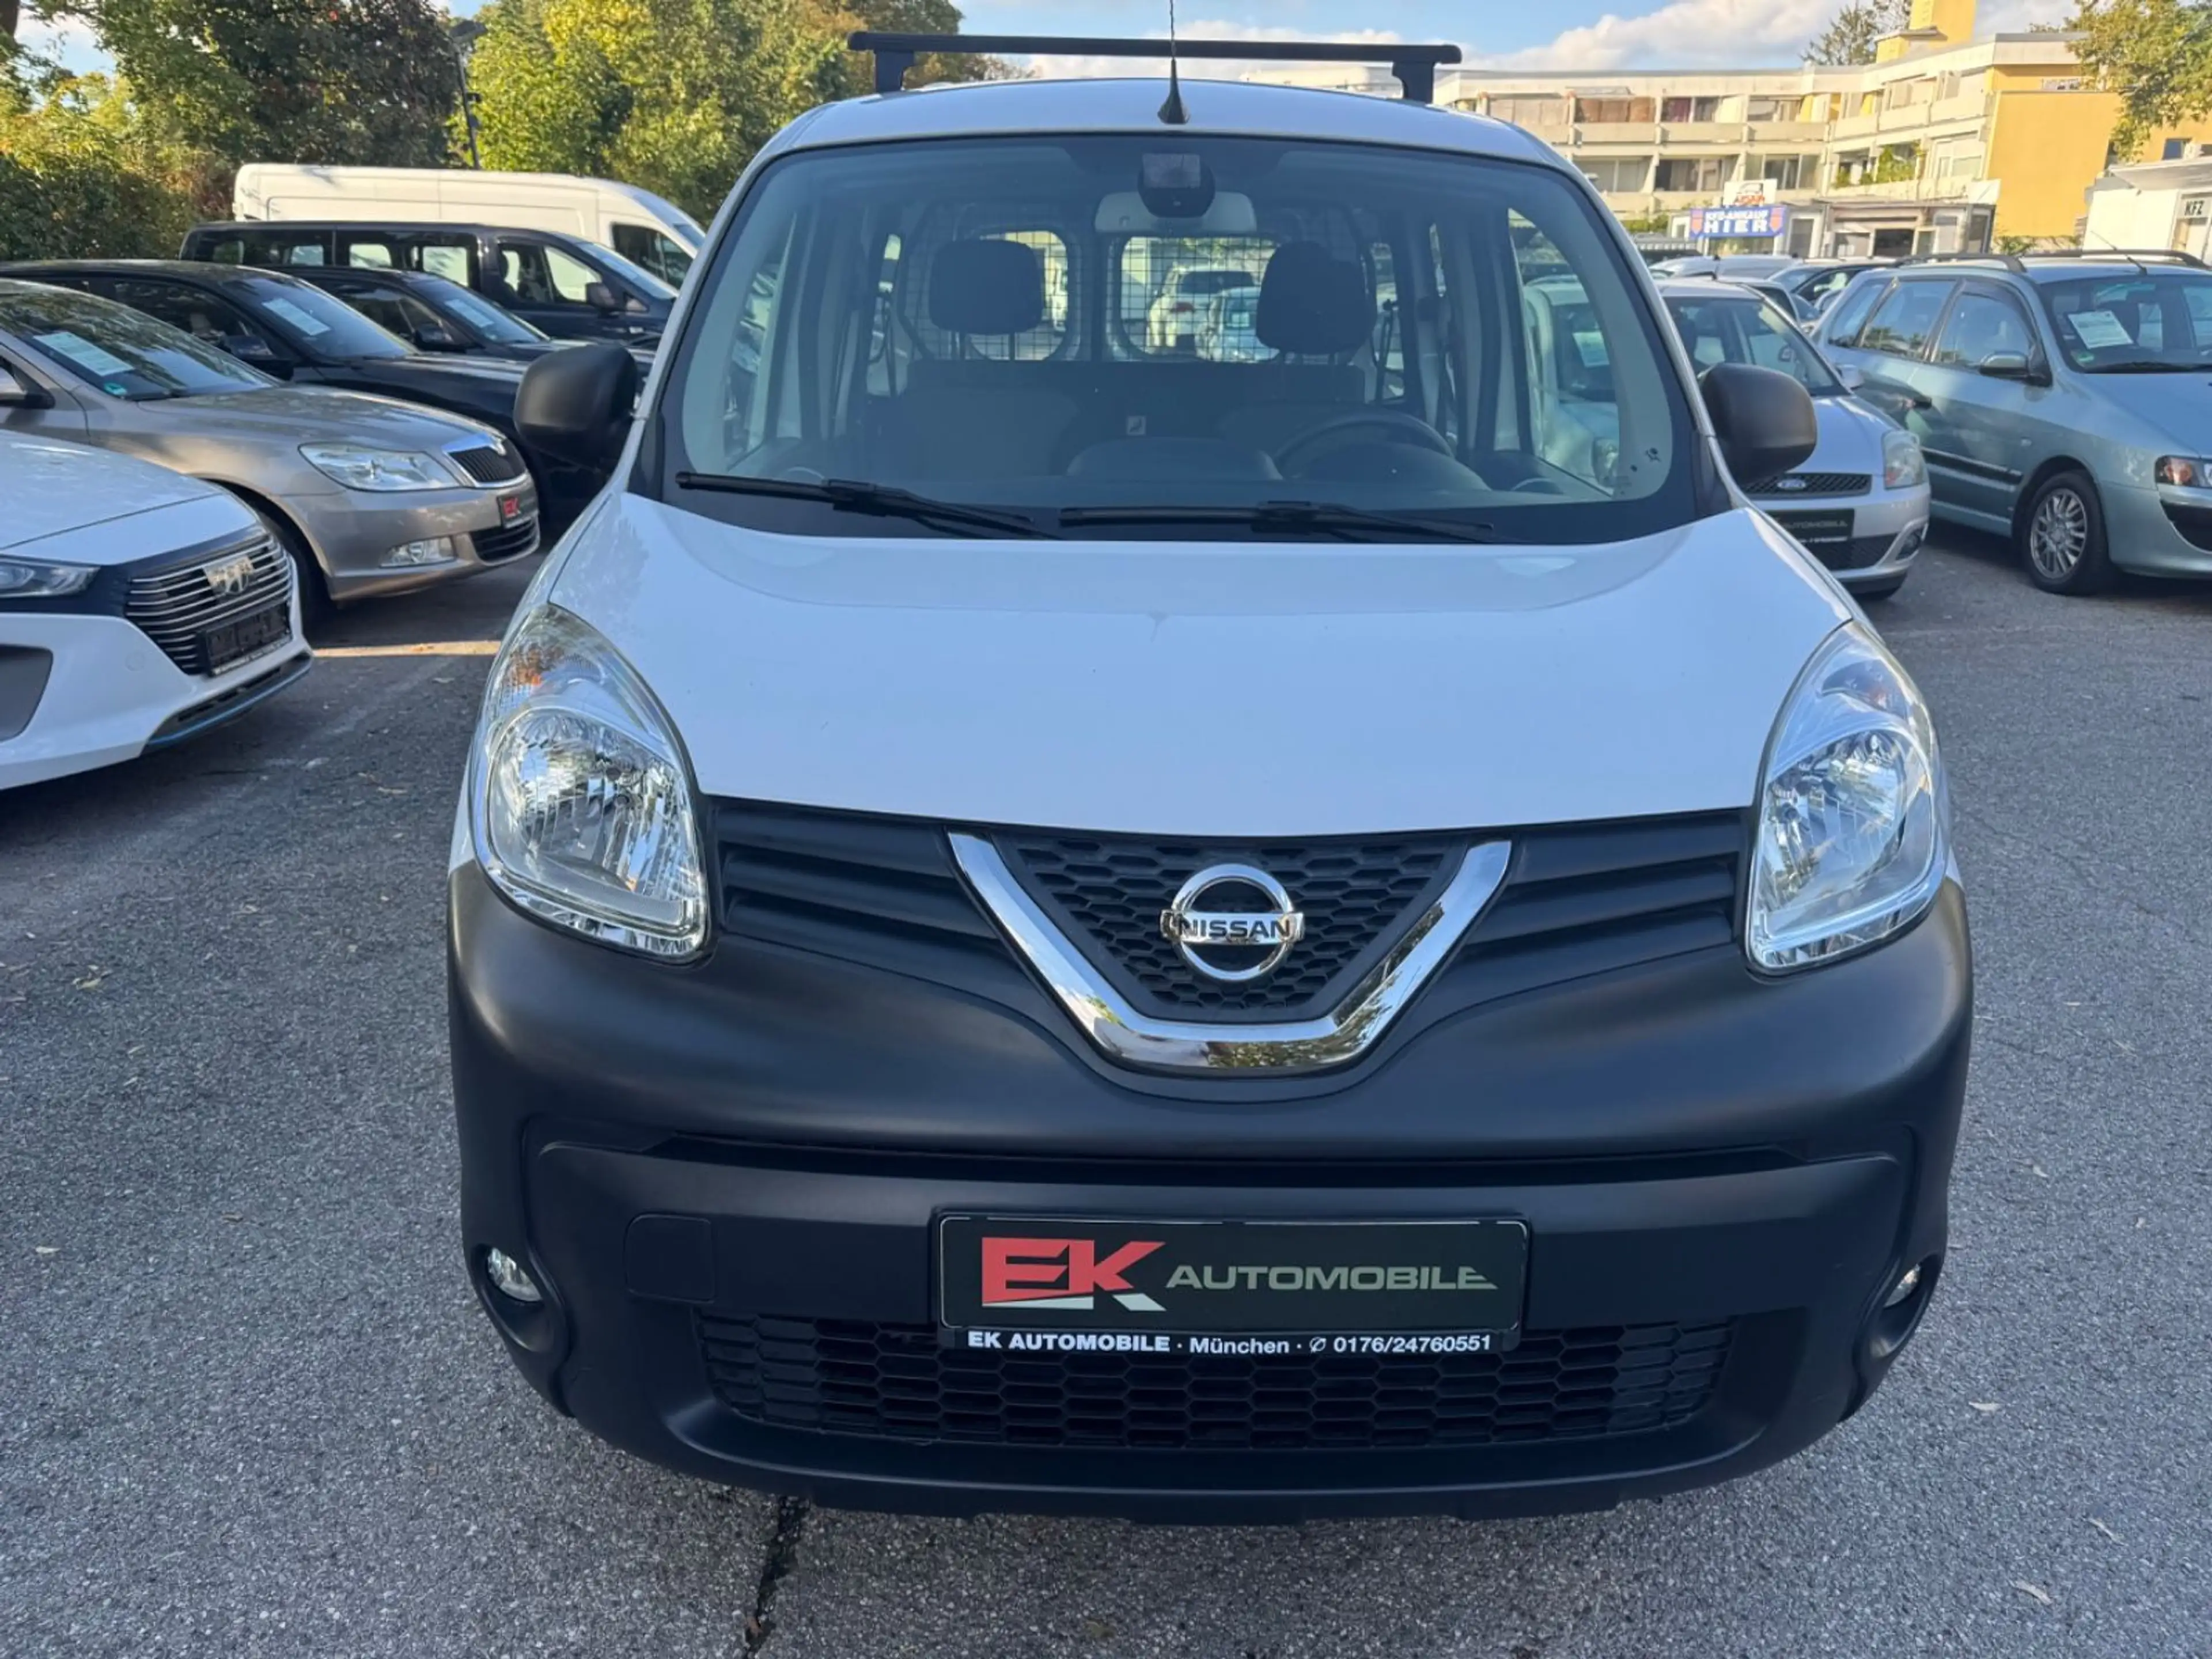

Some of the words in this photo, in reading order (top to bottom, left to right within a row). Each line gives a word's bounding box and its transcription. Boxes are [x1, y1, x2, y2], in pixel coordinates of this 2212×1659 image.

[1179, 919, 1290, 939] NISSAN
[982, 1237, 1166, 1311] EK
[1166, 1266, 1498, 1290] AUTOMOBILE
[967, 1331, 1002, 1349] EK
[1008, 1333, 1171, 1353] AUTOMOBILE
[1189, 1338, 1289, 1354] München
[1333, 1334, 1491, 1354] 0176/24760551
